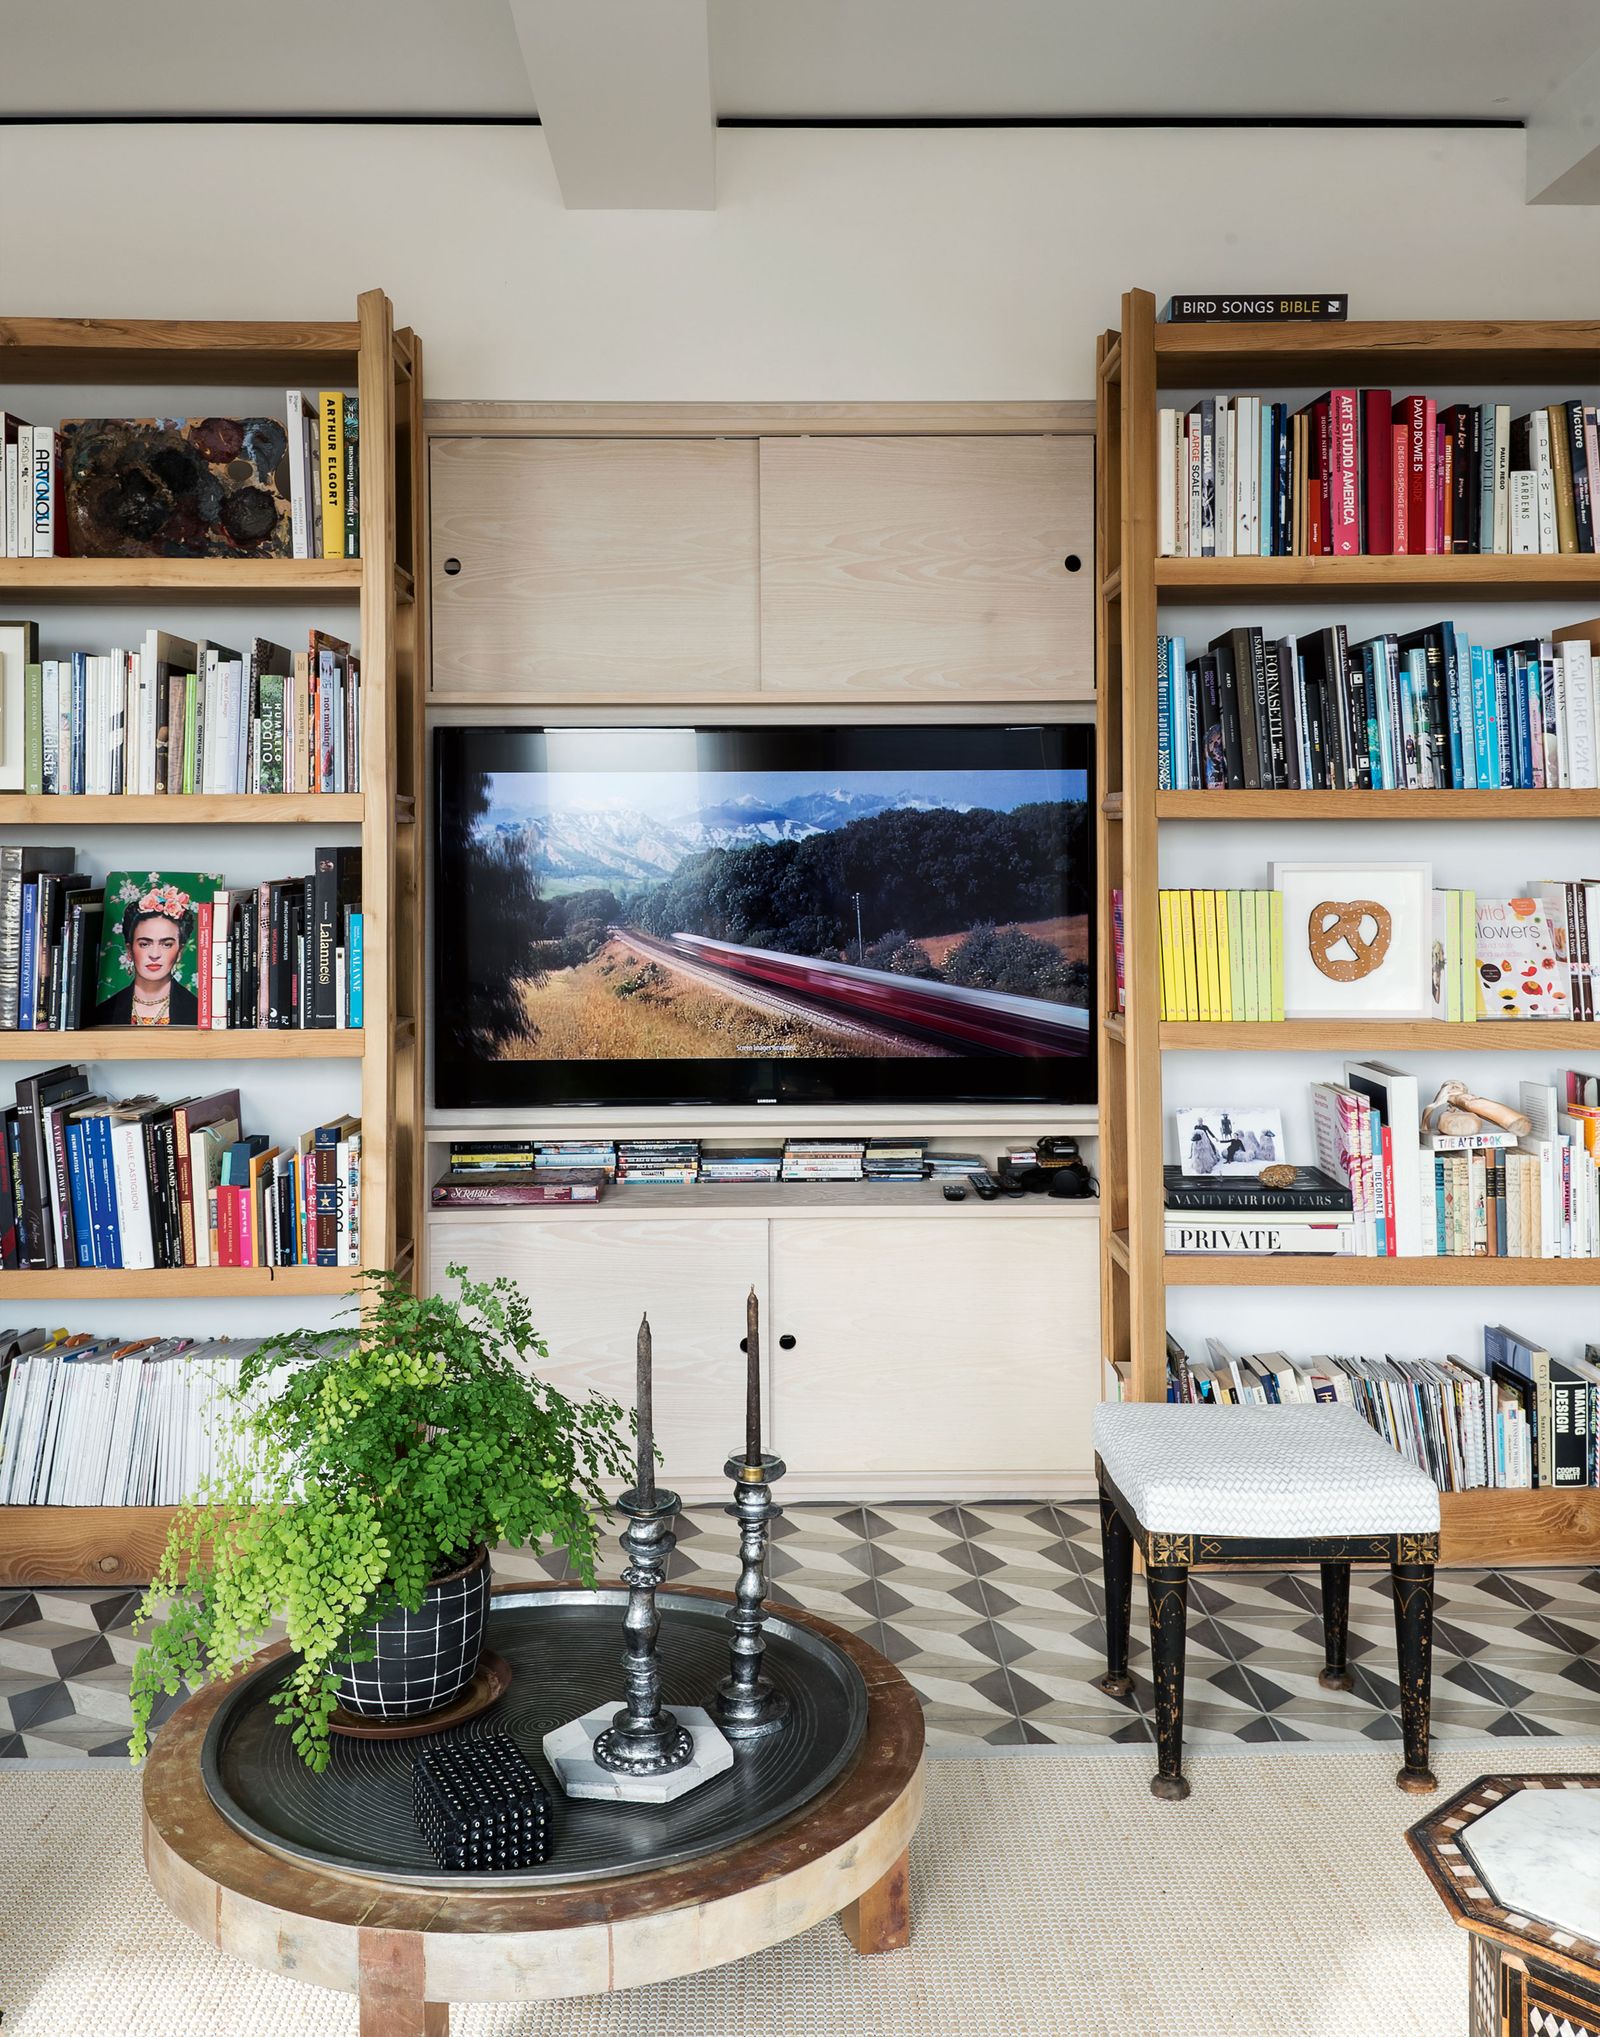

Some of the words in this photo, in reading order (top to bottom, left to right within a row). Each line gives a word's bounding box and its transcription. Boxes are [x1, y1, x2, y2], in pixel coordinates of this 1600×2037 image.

[1182, 301, 1217, 315] BIRD
[1222, 301, 1275, 314] SONGS
[1280, 301, 1320, 314] BIBLE
[1342, 395, 1353, 420] ART
[1414, 399, 1423, 430] DAVID
[327, 399, 339, 451] ARTHUR
[1572, 406, 1584, 449] Victore
[1192, 429, 1200, 462] LARGE
[1203, 434, 1212, 474] BERTOIA
[1342, 422, 1354, 468] STUDIO
[1414, 431, 1423, 462] BOWIE
[1428, 430, 1437, 454] Living
[1429, 454, 1436, 462] in
[35, 449, 50, 483] ART
[346, 446, 355, 481] Rousseau
[1414, 463, 1423, 472] IS
[1429, 463, 1437, 489] Mexico
[1483, 460, 1494, 494] JULIO
[328, 457, 339, 508] ELGORT
[1192, 464, 1200, 497] SCALE
[1414, 473, 1423, 502] INSIDE
[1540, 438, 1552, 535] DRAWING
[35, 488, 50, 534] NOW
[1343, 471, 1355, 526] AMERICA
[1520, 475, 1530, 519] GARDENS
[1254, 634, 1266, 667] ISABEL
[1448, 655, 1456, 668] The
[223, 672, 231, 693] Objects
[1256, 667, 1267, 705] TOLEDO
[1447, 668, 1457, 689] Quilts
[1460, 651, 1470, 693] STEVEN
[1158, 680, 1169, 710] Morris
[1265, 653, 1283, 739] FORNASETTI
[1450, 689, 1457, 697] of
[1556, 666, 1566, 712] ROOMS
[1187, 695, 1198, 743] alfresco
[1450, 697, 1458, 716] Gee's
[1462, 694, 1473, 748] GAMBREL
[262, 703, 273, 763] OUDOLF
[274, 703, 282, 762] HUMMELO
[322, 713, 332, 748] making
[1157, 712, 1169, 748] Lapidus
[24, 928, 32, 943] THE
[242, 913, 250, 939] Bourgeois
[70, 952, 78, 966] living
[215, 953, 223, 967] WA
[242, 939, 250, 956] Louise
[319, 923, 332, 985] Lalanne(s)
[1569, 938, 1577, 955] twist
[352, 949, 361, 993] LALANNE
[23, 976, 31, 999] STYLE
[54, 1130, 62, 1152] YEAR
[125, 1130, 135, 1161] ACHILLE
[148, 1123, 156, 1144] Treasures
[165, 1128, 173, 1144] TOM
[166, 1144, 174, 1154] OF
[12, 1152, 21, 1178] Bringing
[56, 1152, 63, 1162] IN
[167, 1154, 176, 1187] FINLAND
[14, 1179, 22, 1199] Nature
[57, 1163, 67, 1202] FLOWERS
[128, 1161, 139, 1212] CASTIGLIONI
[450, 1187, 497, 1200] SCRABBLE
[16, 1199, 24, 1218] Home
[1175, 1194, 1223, 1205] VANITY
[1227, 1194, 1258, 1206] FAIR
[1290, 1195, 1332, 1206] YEARS
[1563, 1181, 1571, 1222] EXPERIENCE
[1180, 1229, 1281, 1250] PRIVATE
[1538, 1364, 1548, 1405] GYPSY
[1556, 1389, 1569, 1433] DESIGN
[1574, 1389, 1586, 1435] MAKING
